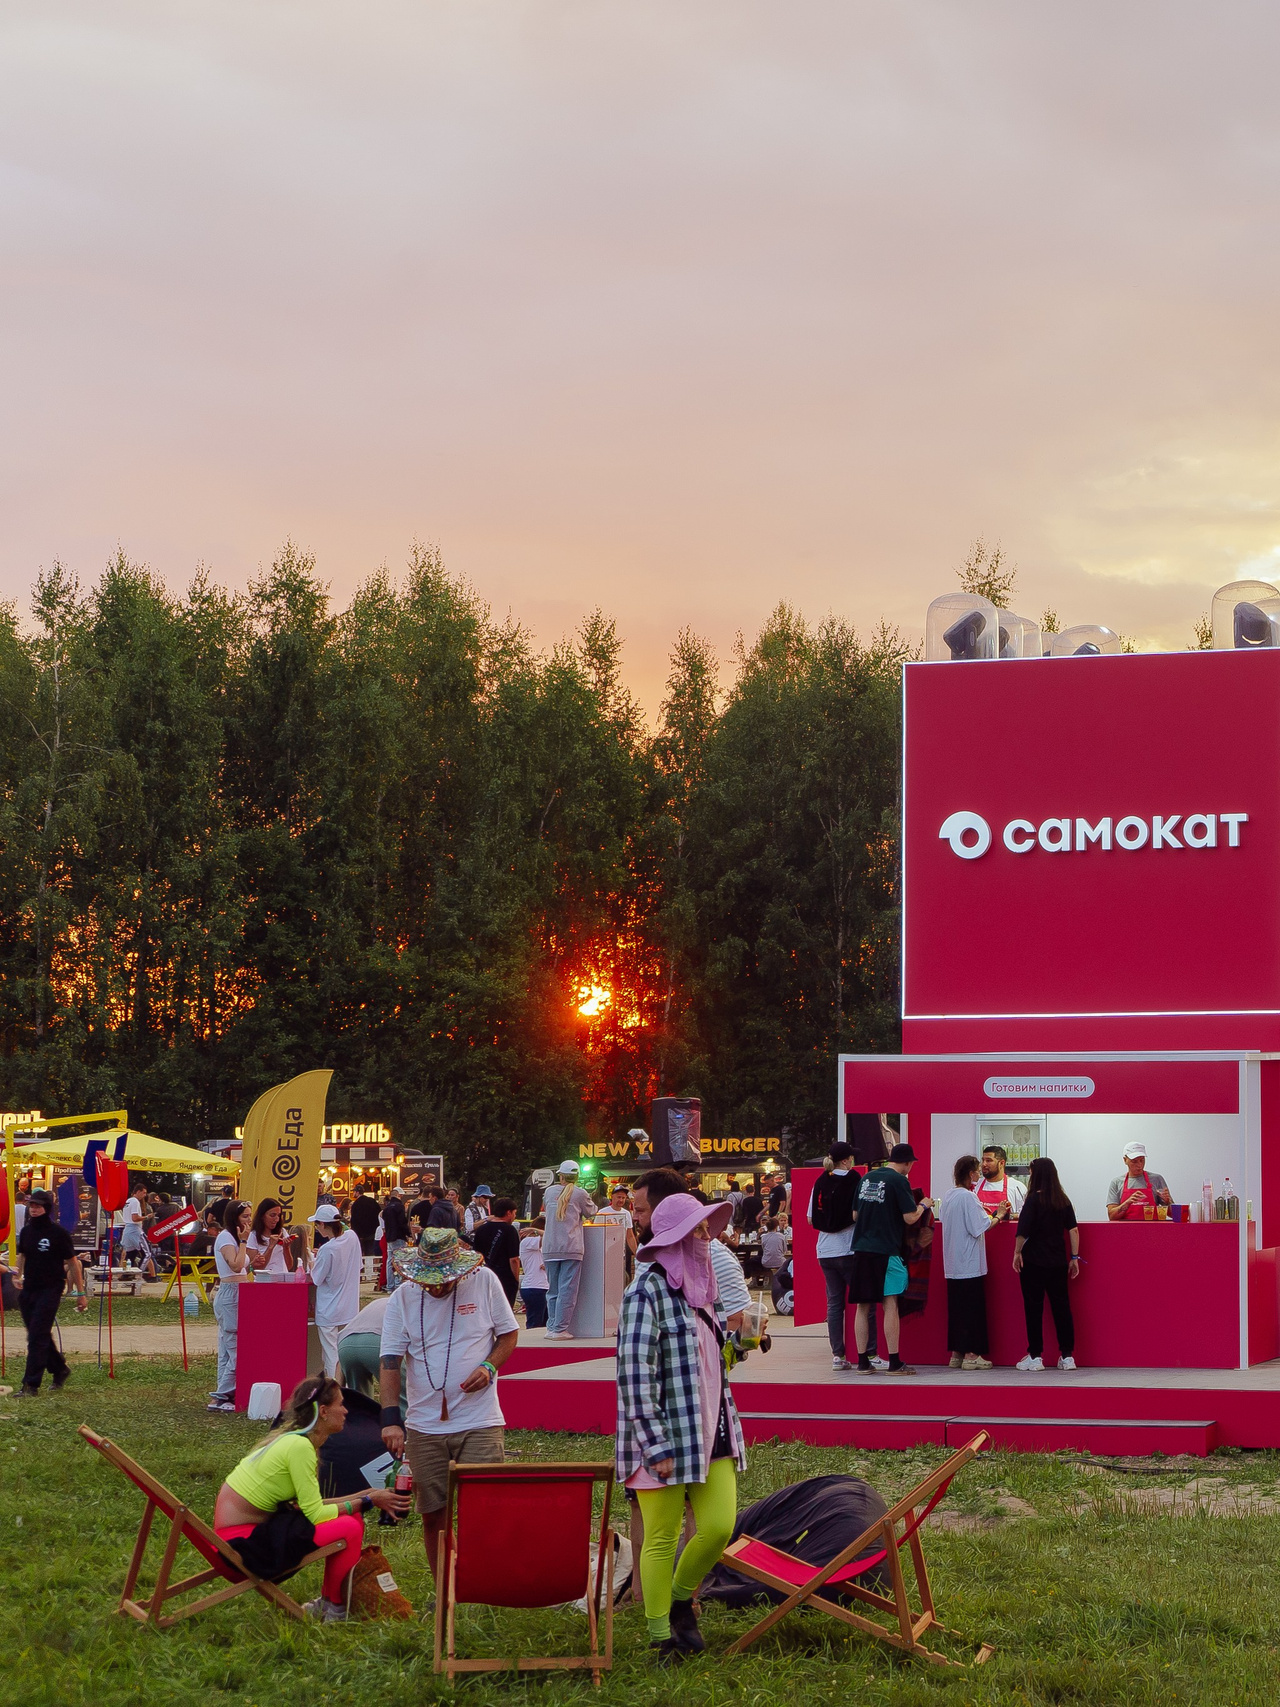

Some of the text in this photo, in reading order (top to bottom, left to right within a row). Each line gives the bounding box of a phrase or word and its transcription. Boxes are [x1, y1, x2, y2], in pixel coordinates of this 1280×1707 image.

[1003, 813, 1249, 853] самокат
[991, 1082, 1087, 1092] Готовим напитки
[331, 1123, 392, 1144] ГРИЛЬ
[579, 1142, 630, 1159] NEW
[700, 1137, 780, 1153] BURGER
[180, 1162, 204, 1171] Яндекс
[278, 1108, 304, 1231] екс Еда
